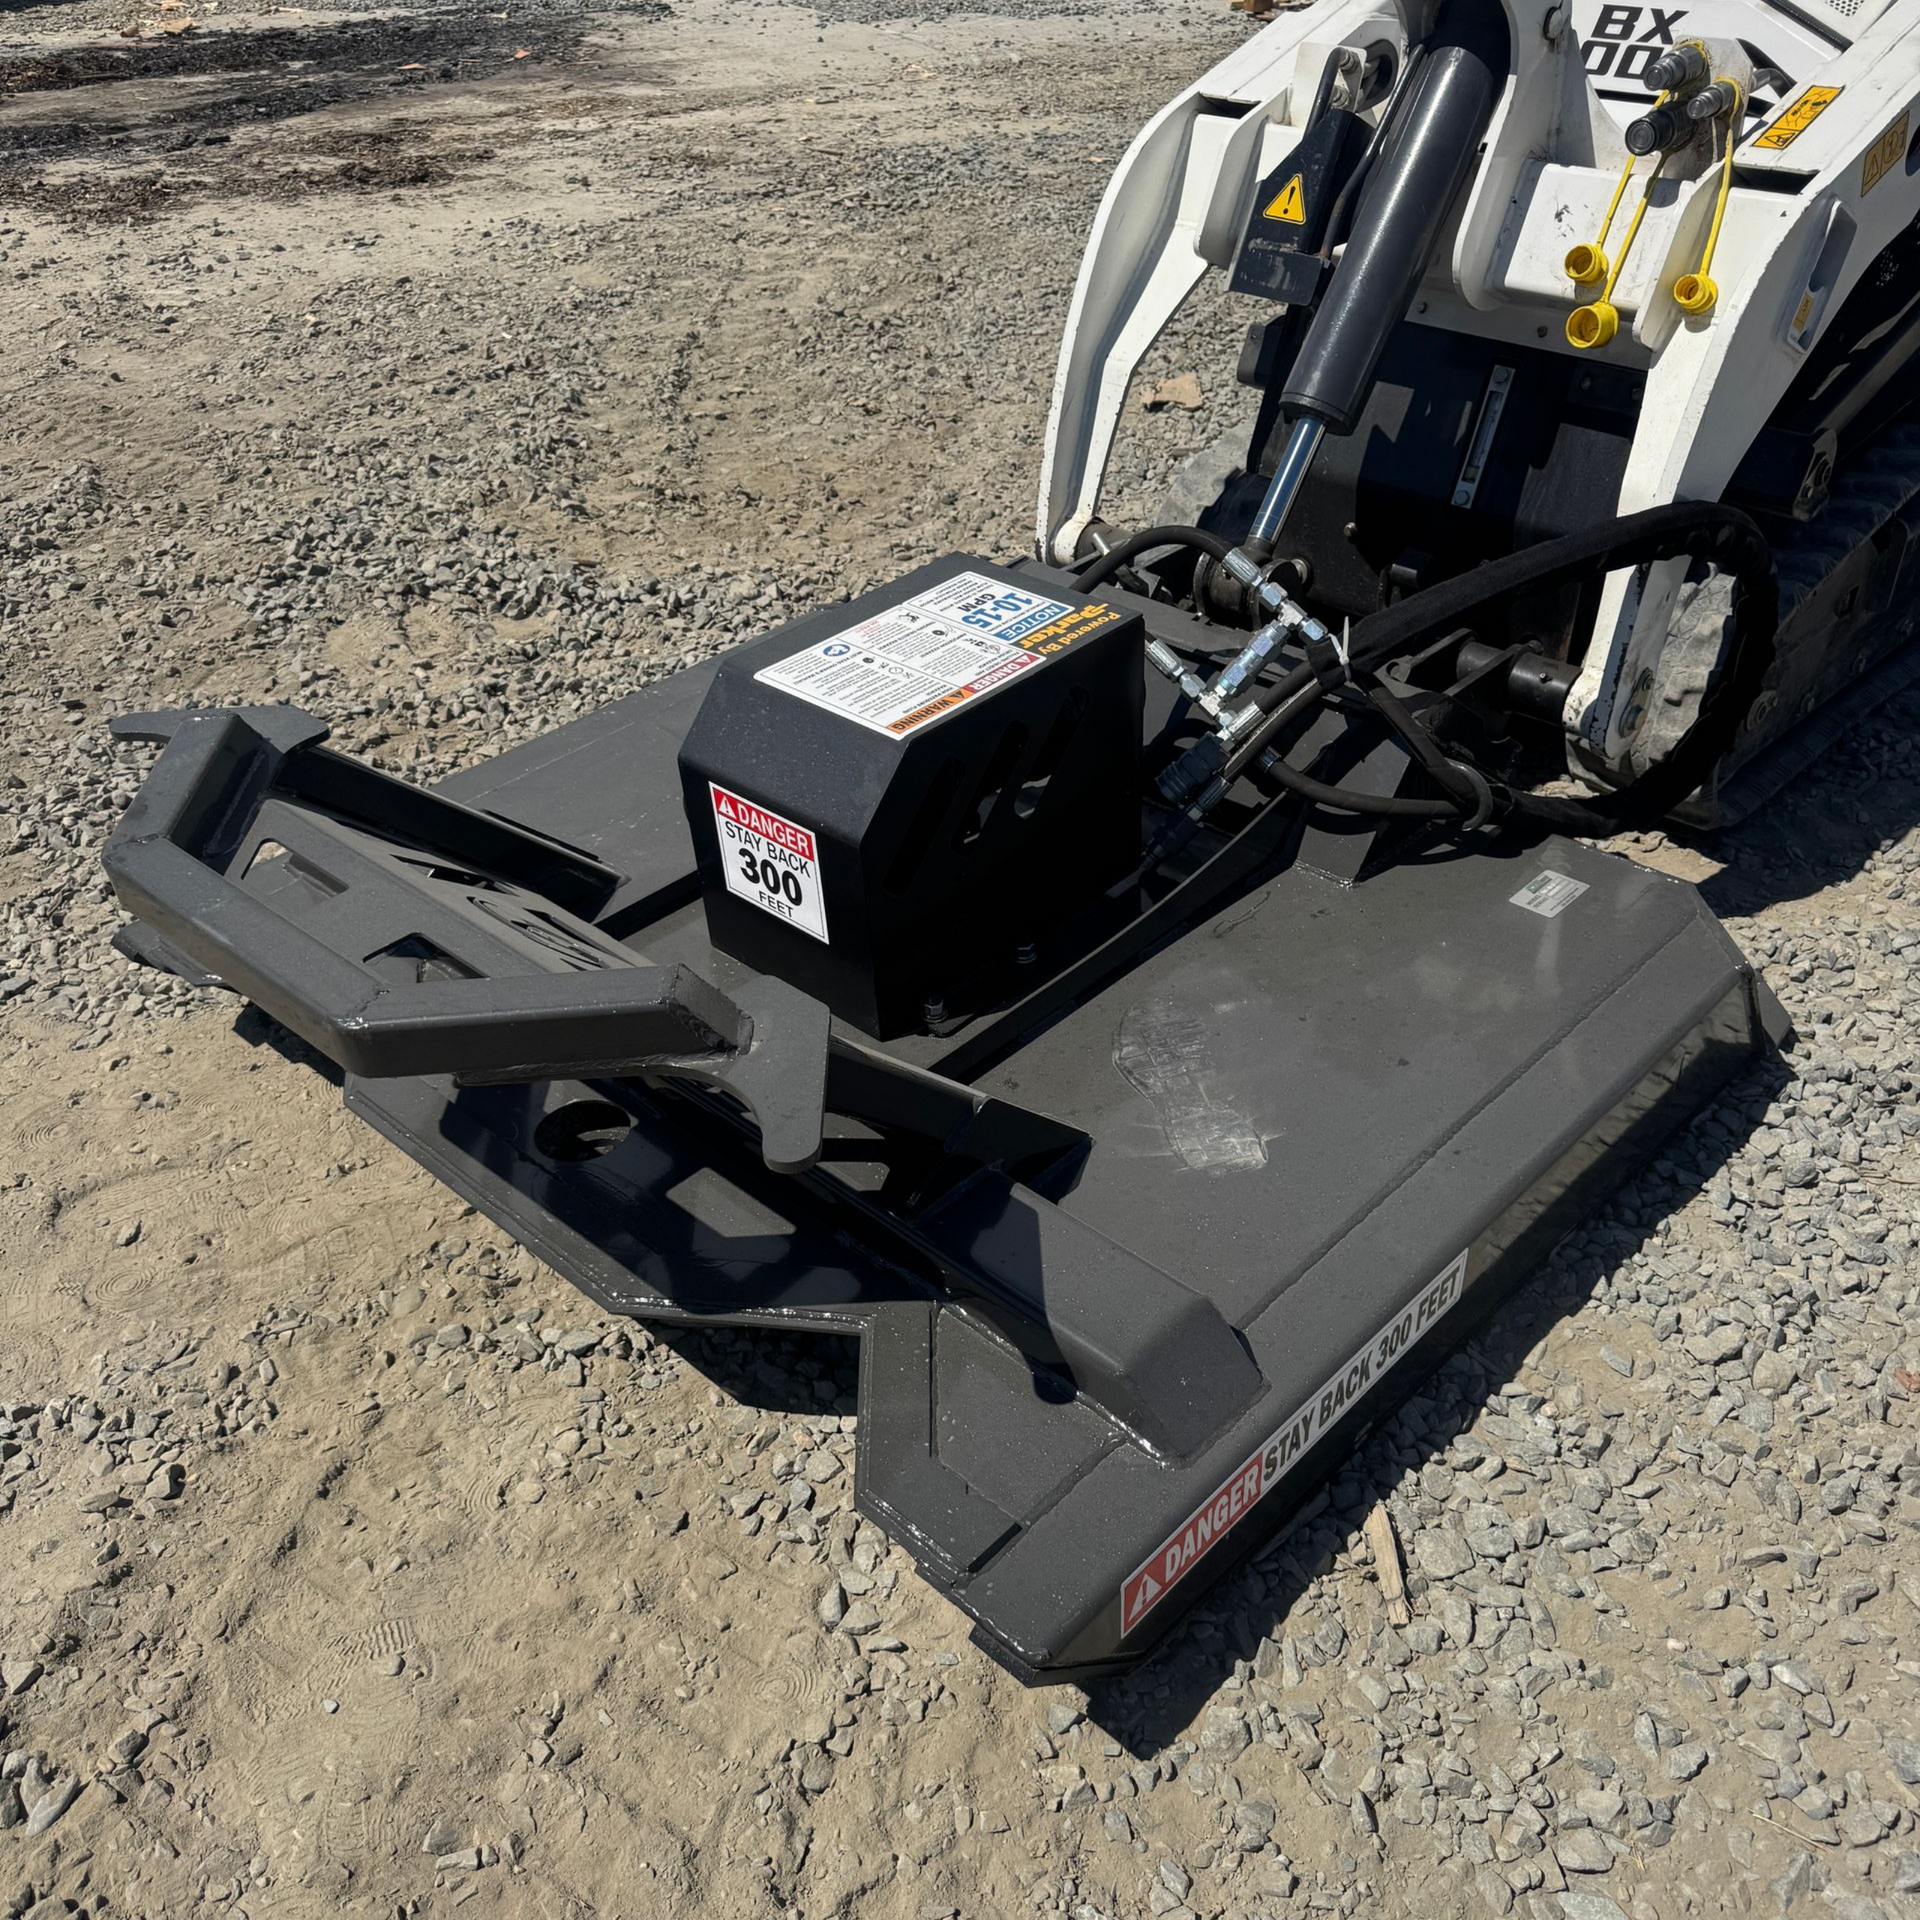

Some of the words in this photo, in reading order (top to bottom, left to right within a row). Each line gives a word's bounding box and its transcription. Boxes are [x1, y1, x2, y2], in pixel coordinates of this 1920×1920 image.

[1591, 4, 1689, 45] BX
[958, 593, 996, 612] GPM
[961, 592, 1033, 629] 10-15
[1000, 605, 1061, 637] NOTICE
[1017, 603, 1108, 648] Parker
[1060, 612, 1121, 644] Powered
[1038, 642, 1064, 654] By
[967, 662, 1022, 690] DANGER
[890, 698, 954, 731] WARNING
[737, 803, 810, 856] DANGER
[725, 821, 761, 852] STAY
[767, 841, 811, 879] BACK
[738, 847, 802, 907] 300
[759, 890, 794, 918] FEET
[1164, 1464, 1261, 1580] DANGER
[1263, 1412, 1315, 1482] STAY
[1318, 1360, 1371, 1429] BACK
[1376, 1317, 1411, 1370] 300
[1415, 1270, 1460, 1334] FEET
